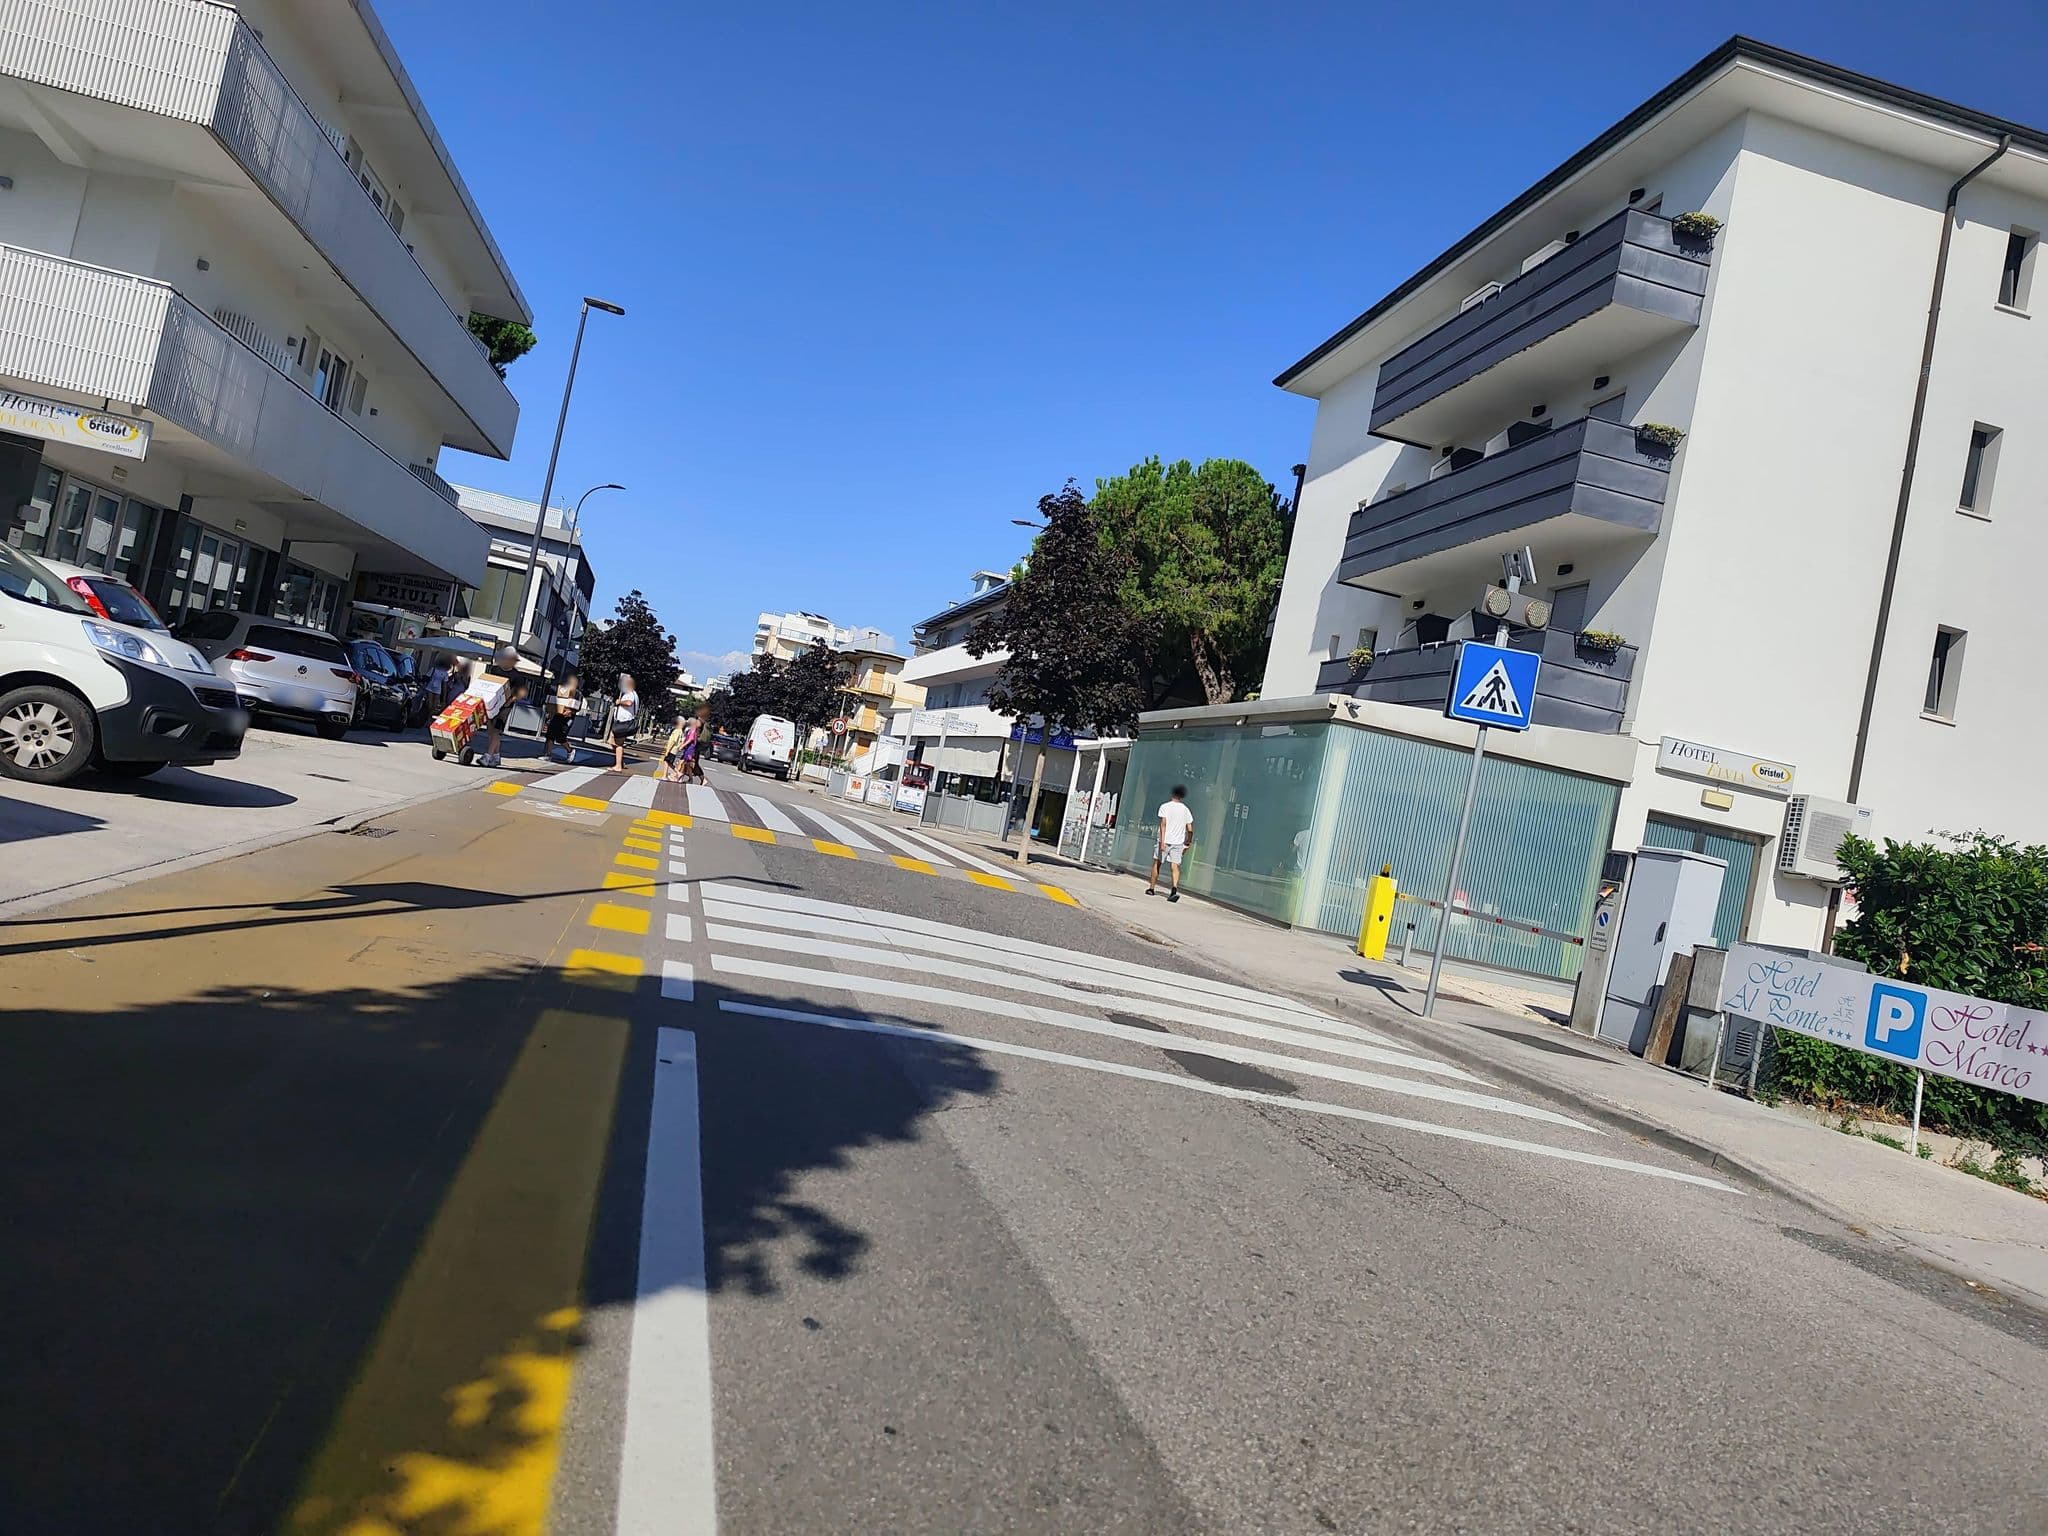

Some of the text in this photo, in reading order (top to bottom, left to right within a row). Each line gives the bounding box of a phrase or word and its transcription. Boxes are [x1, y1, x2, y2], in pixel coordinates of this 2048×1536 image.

[1, 393, 60, 420] HOTEL
[376, 583, 439, 606] FRIULI
[1670, 741, 1719, 765] HOTEL
[1748, 960, 1823, 998] Hotel
[1725, 982, 1828, 1032] Al Ponte
[1874, 993, 1915, 1043] P
[1930, 1005, 2031, 1050] Hotel
[1925, 1040, 2032, 1089] Marco
